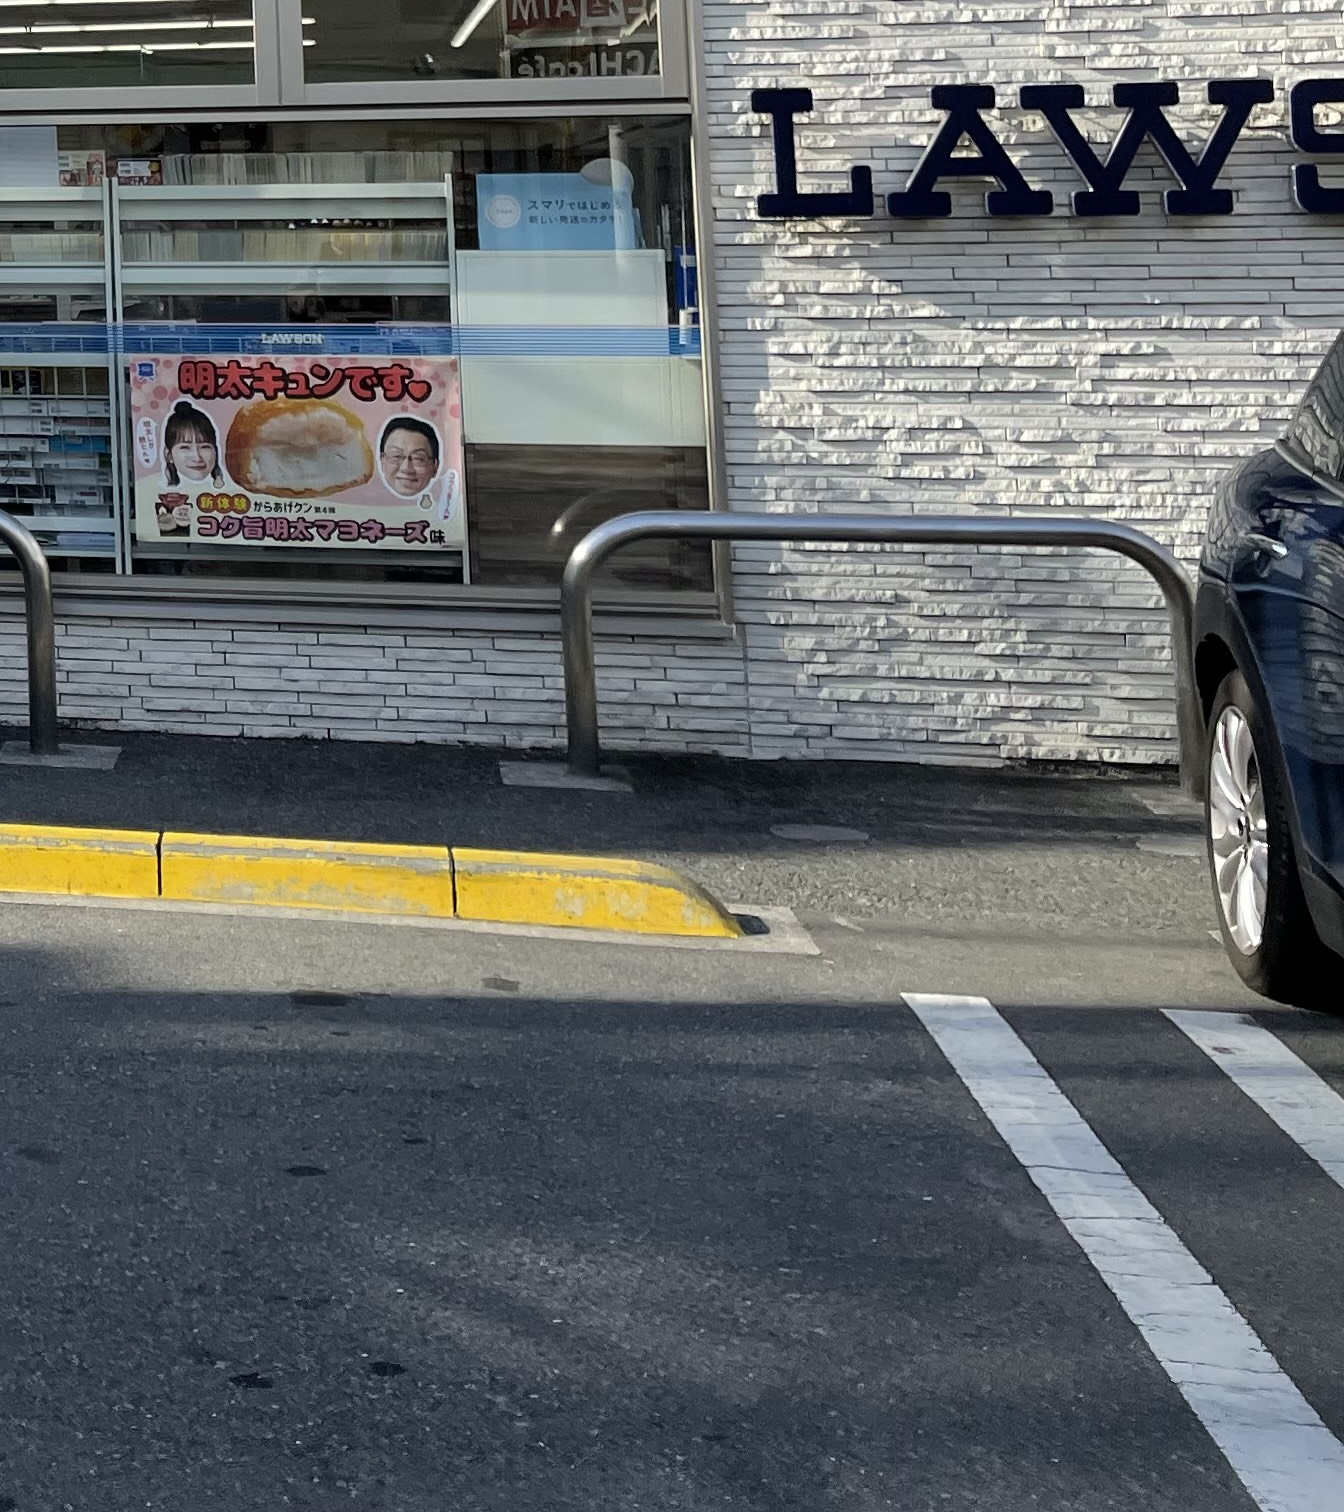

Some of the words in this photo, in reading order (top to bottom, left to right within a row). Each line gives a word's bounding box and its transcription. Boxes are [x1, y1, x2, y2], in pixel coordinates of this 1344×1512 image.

[261, 333, 323, 344] LAWSON
[253, 500, 313, 514] からあげクン
[197, 515, 446, 545] コク旨明太マヨネーズ味
